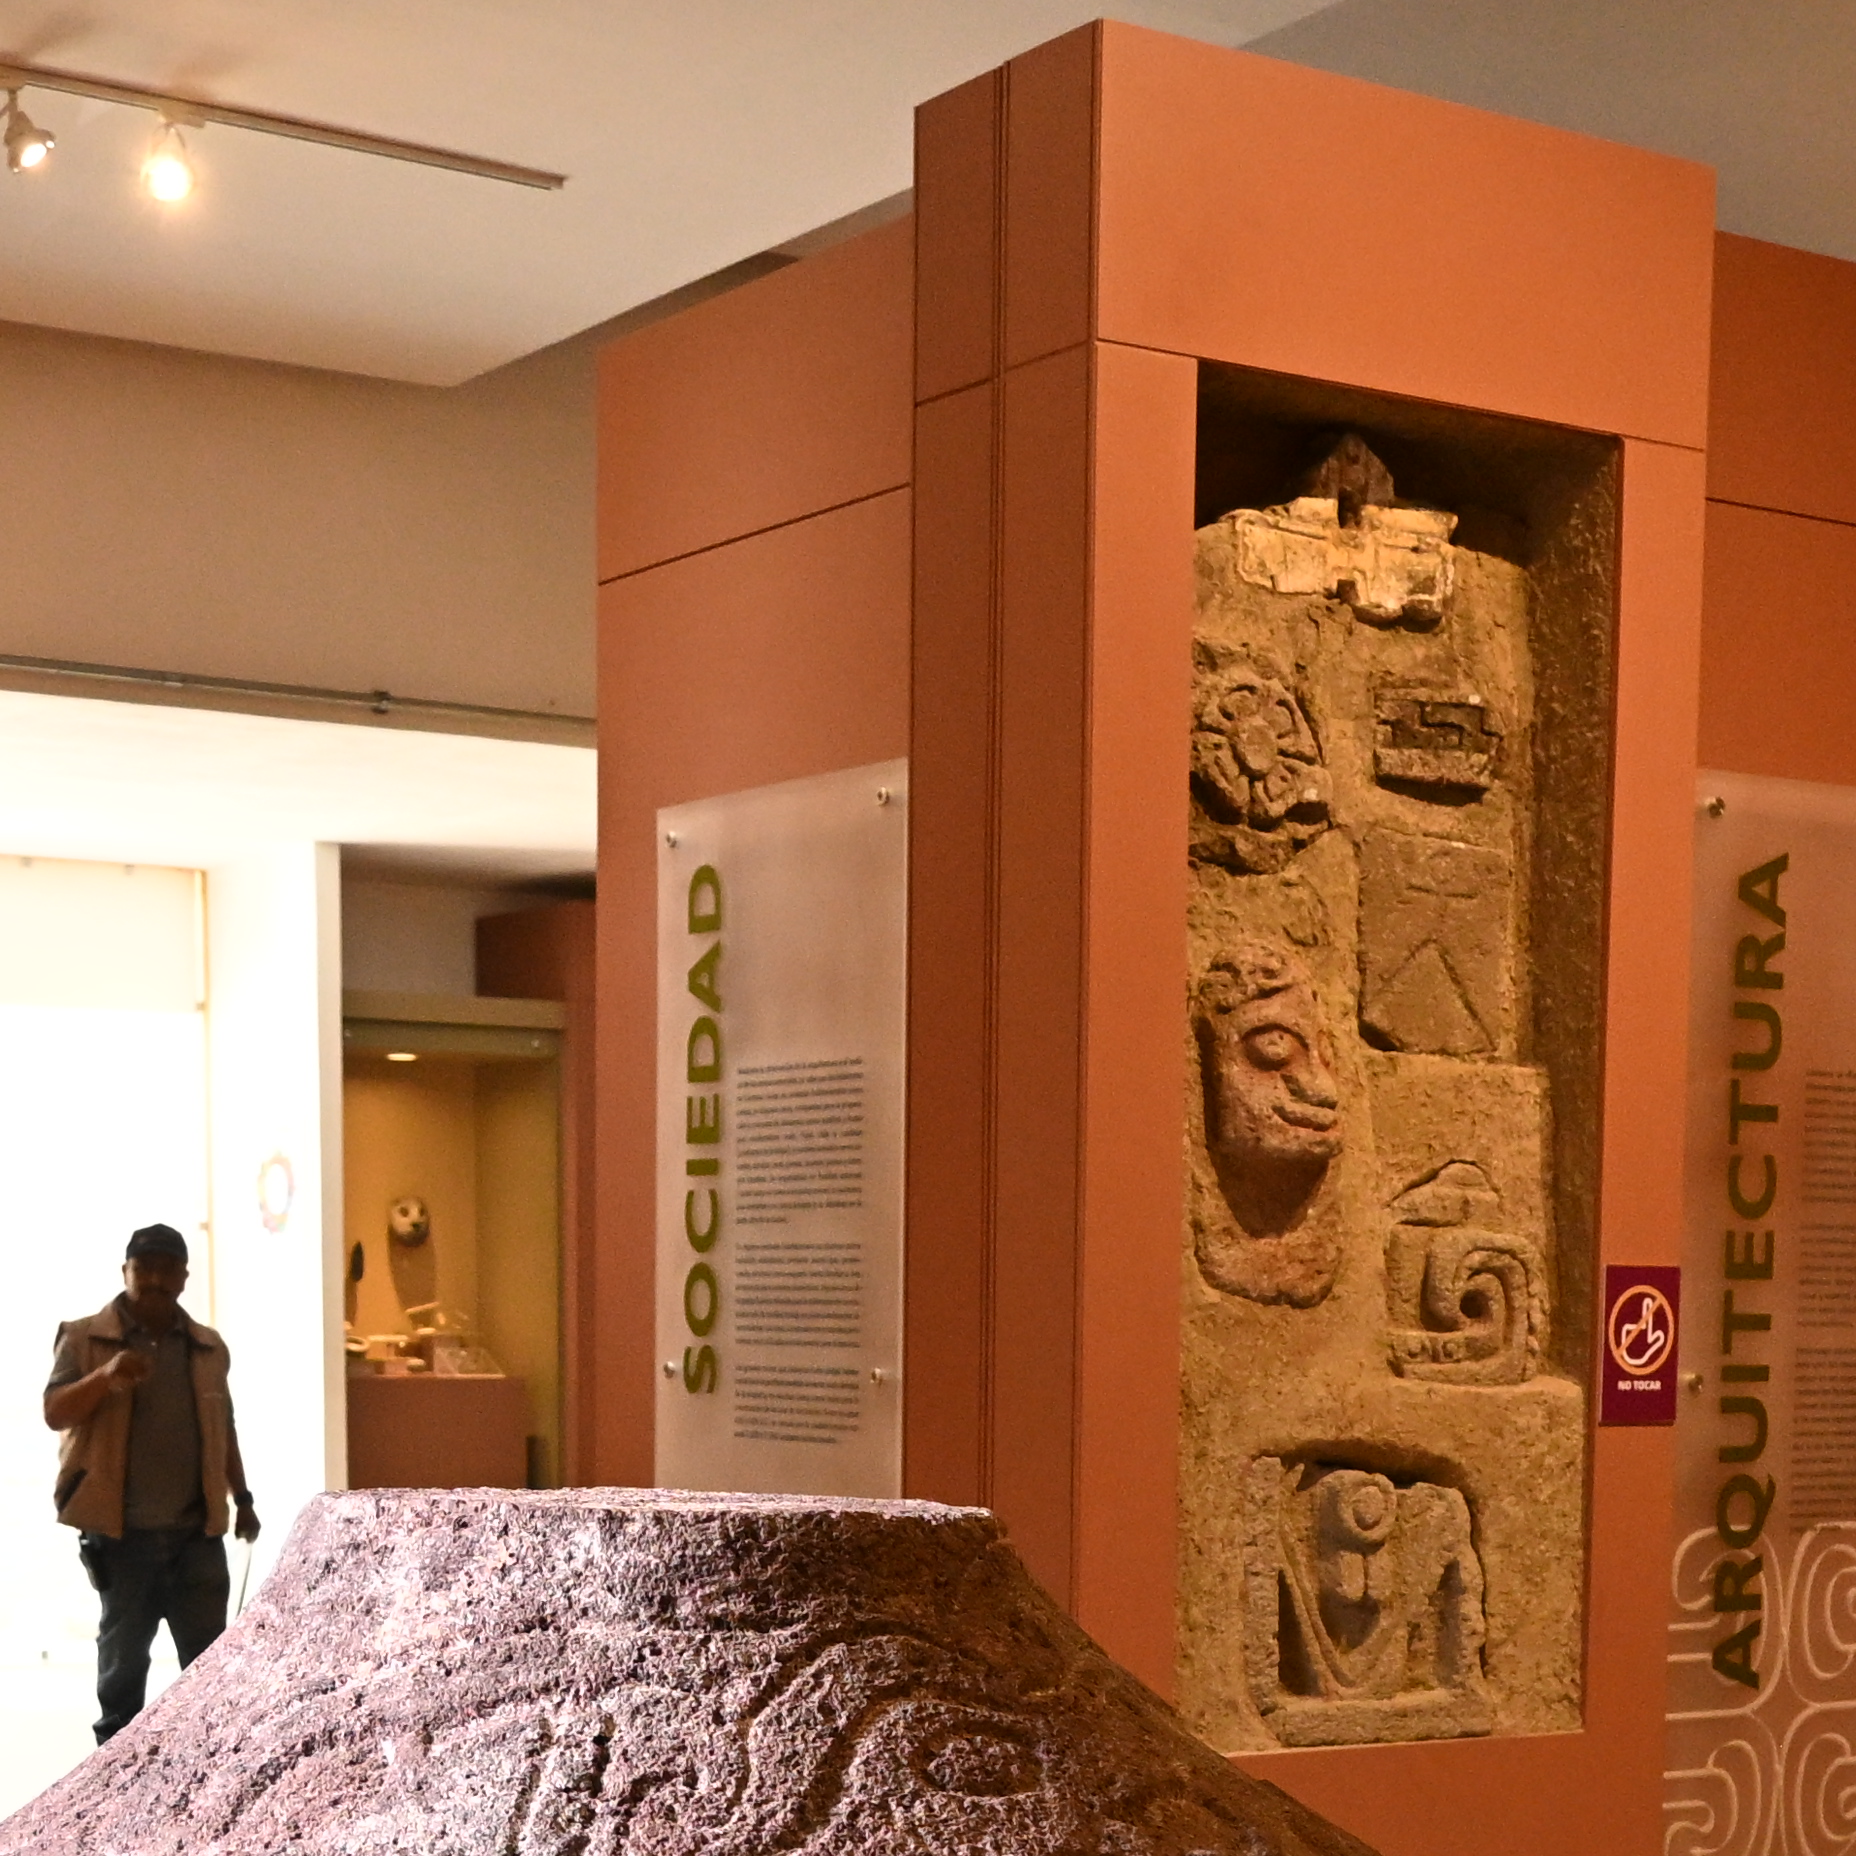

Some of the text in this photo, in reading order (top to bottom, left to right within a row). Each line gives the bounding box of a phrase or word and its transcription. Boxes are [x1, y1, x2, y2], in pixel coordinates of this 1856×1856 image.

[683, 862, 728, 1396] SOCIEDAD
[1618, 1380, 1661, 1391] NO TOCAR
[1711, 851, 1791, 1690] ARQUITECTURA
